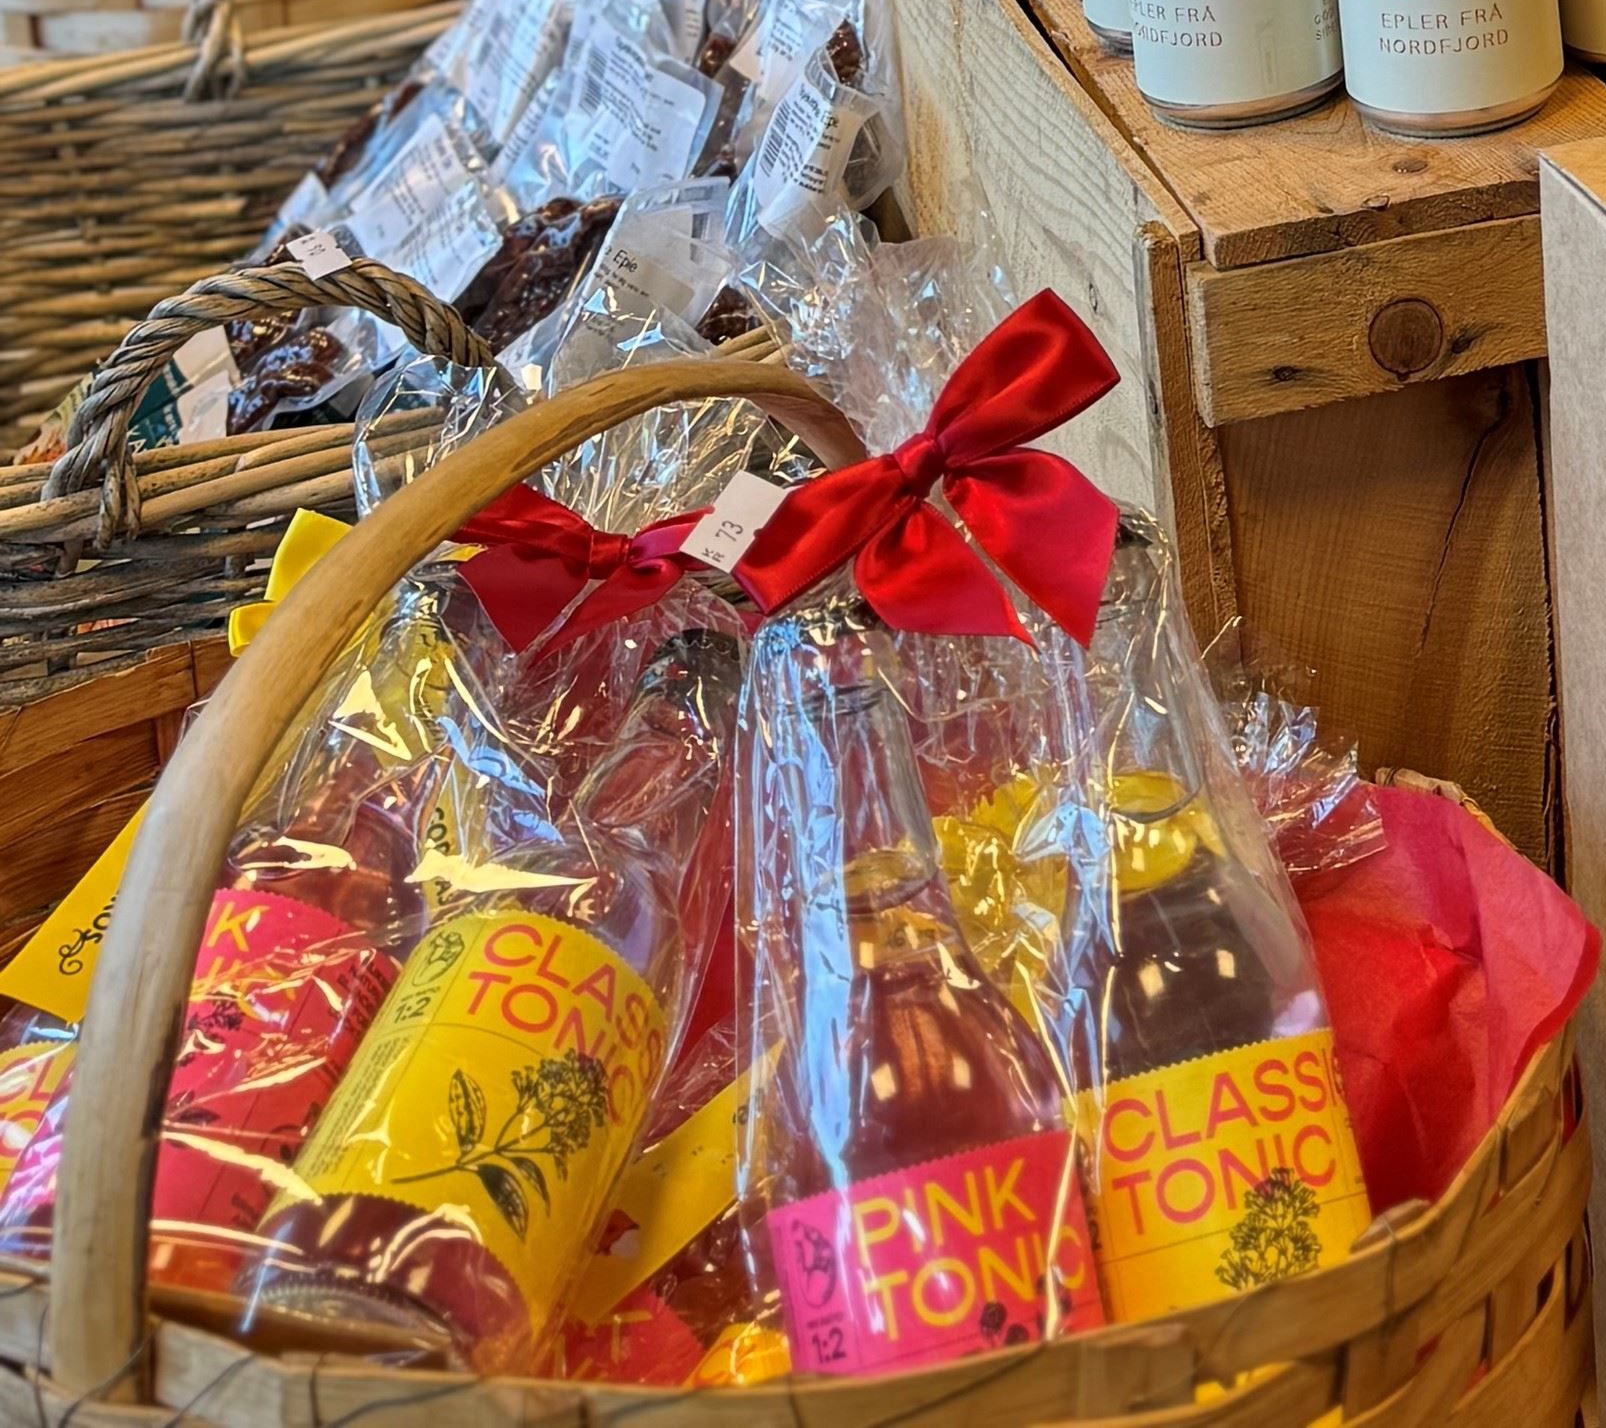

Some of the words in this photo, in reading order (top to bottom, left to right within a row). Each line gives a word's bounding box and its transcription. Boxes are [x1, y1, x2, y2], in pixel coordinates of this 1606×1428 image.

[1380, 11, 1448, 32] EPLER
[1379, 26, 1510, 57] NORDFJORD
[715, 520, 744, 543] 73
[1111, 1124, 1338, 1237] TONIC
[853, 1158, 1040, 1267] PINK
